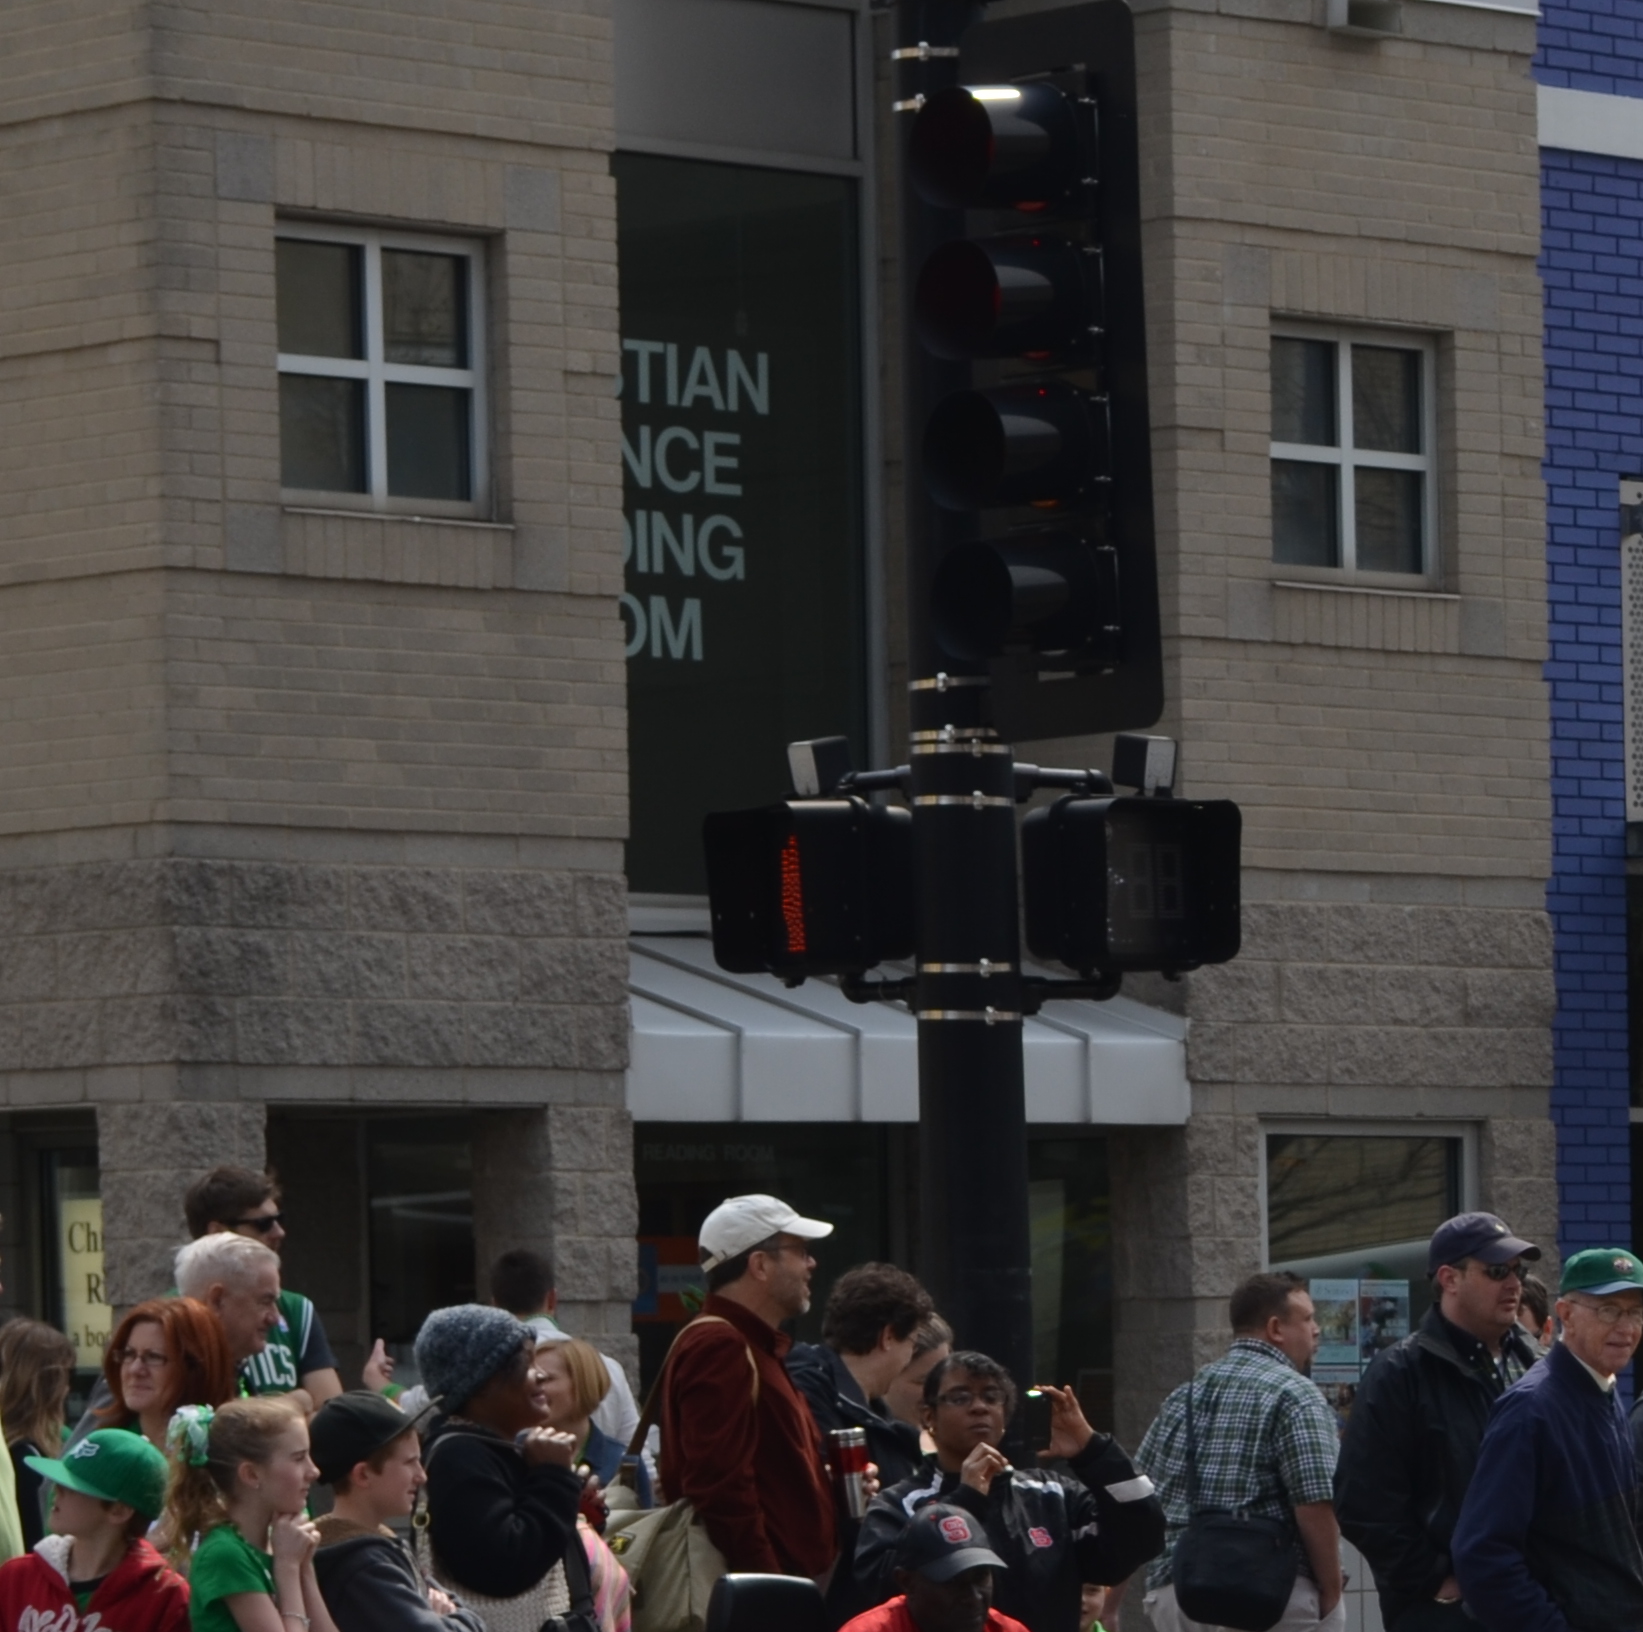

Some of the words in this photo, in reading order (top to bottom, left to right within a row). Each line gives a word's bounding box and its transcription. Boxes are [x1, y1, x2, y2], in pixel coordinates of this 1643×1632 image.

[615, 338, 769, 415] TIAN
[68, 1221, 104, 1253] Ch
[86, 1267, 107, 1304] R
[243, 1343, 297, 1388] TICS
